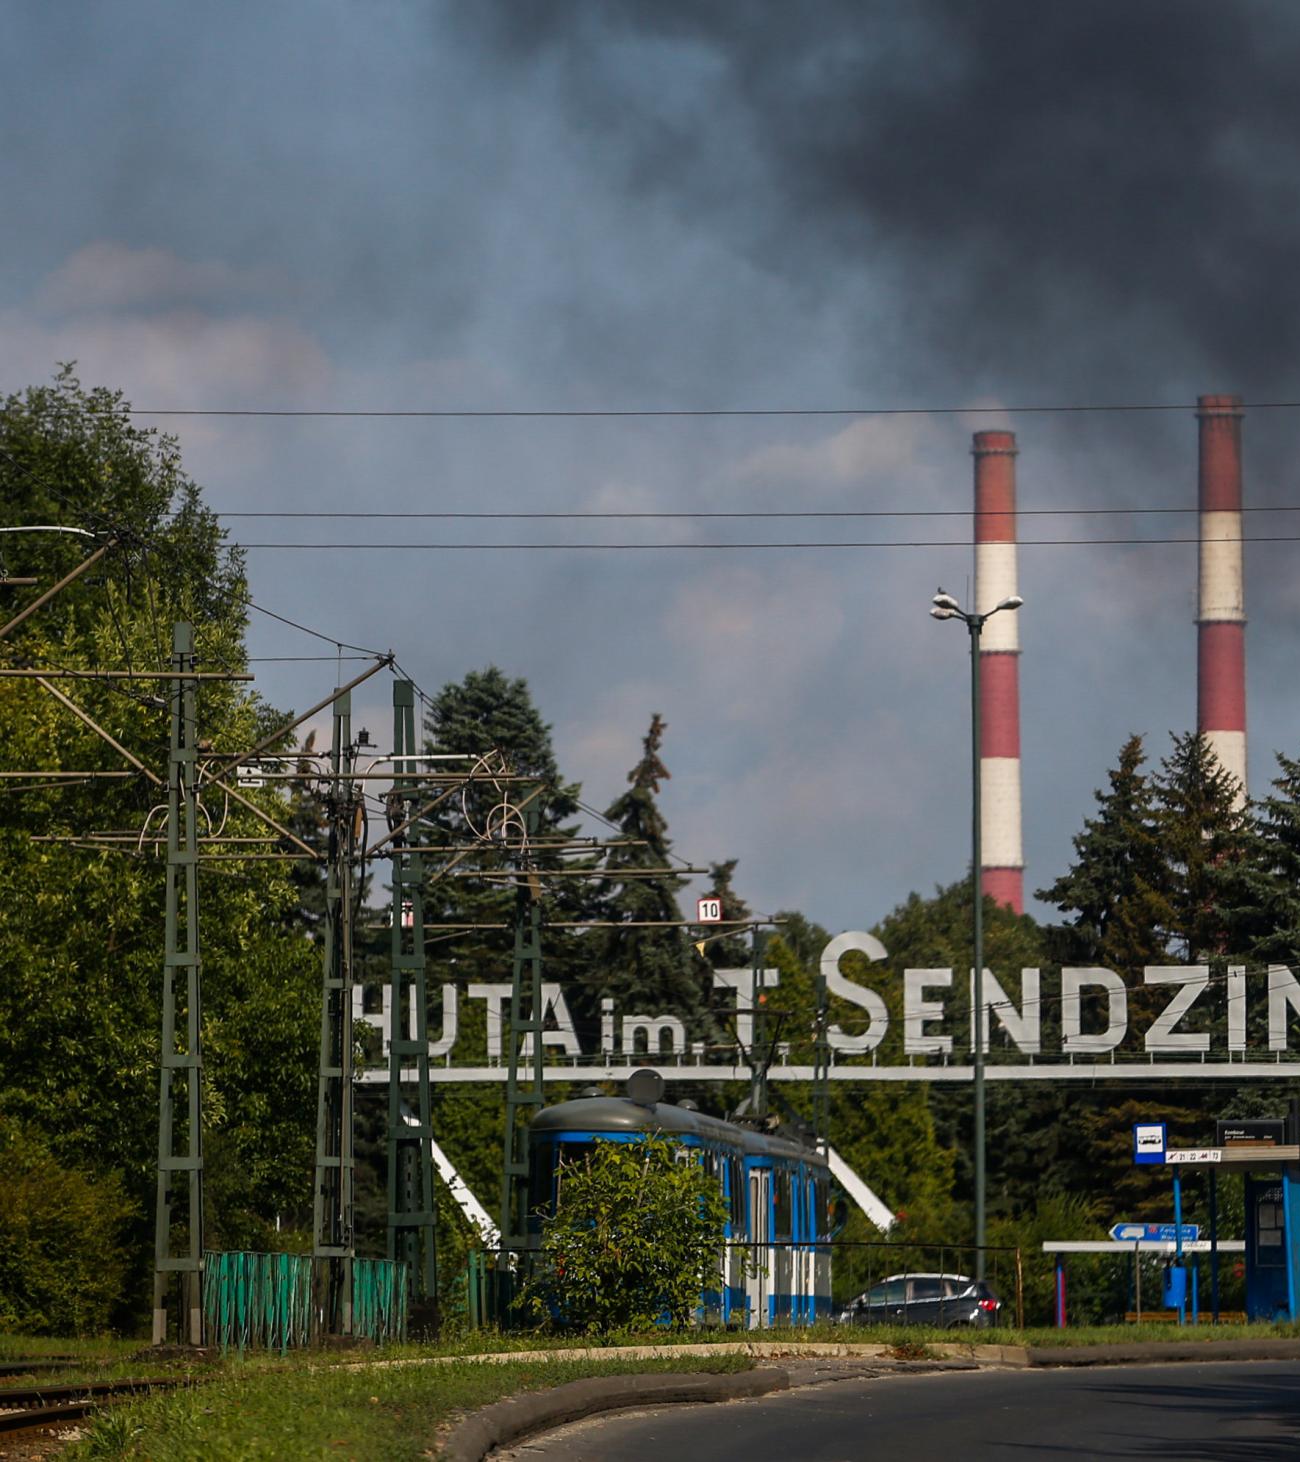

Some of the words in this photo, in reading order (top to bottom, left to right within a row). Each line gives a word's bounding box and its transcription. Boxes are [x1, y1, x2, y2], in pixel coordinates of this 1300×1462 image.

[702, 903, 718, 917] 10
[352, 983, 583, 1057] HUTA
[601, 998, 705, 1055] im.
